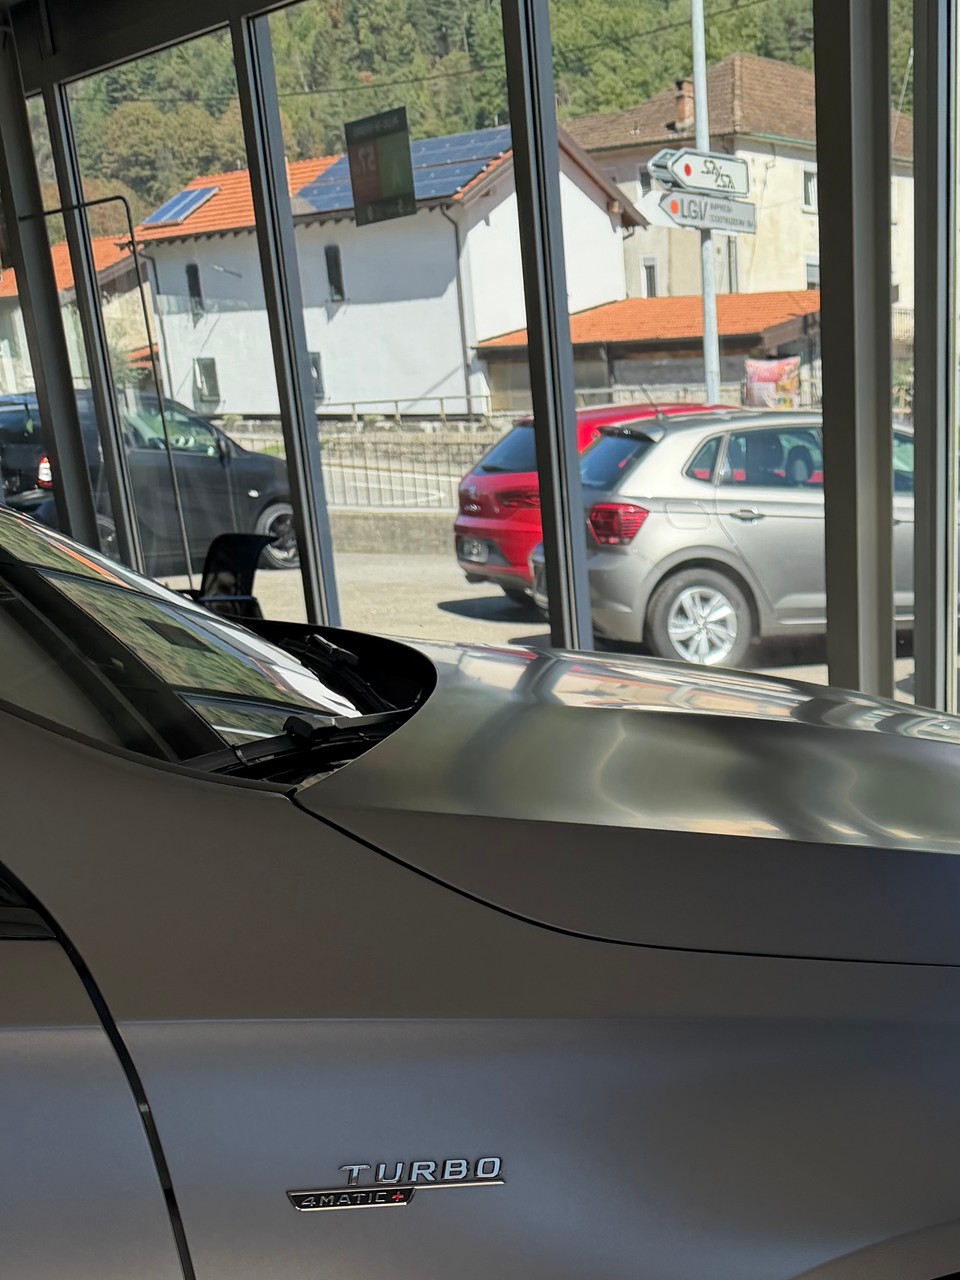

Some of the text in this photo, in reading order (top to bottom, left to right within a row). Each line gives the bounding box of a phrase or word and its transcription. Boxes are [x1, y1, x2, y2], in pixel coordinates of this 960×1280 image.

[680, 198, 708, 221] LGV
[338, 1156, 502, 1186] TURBO
[301, 1190, 404, 1207] 4MATIC+
